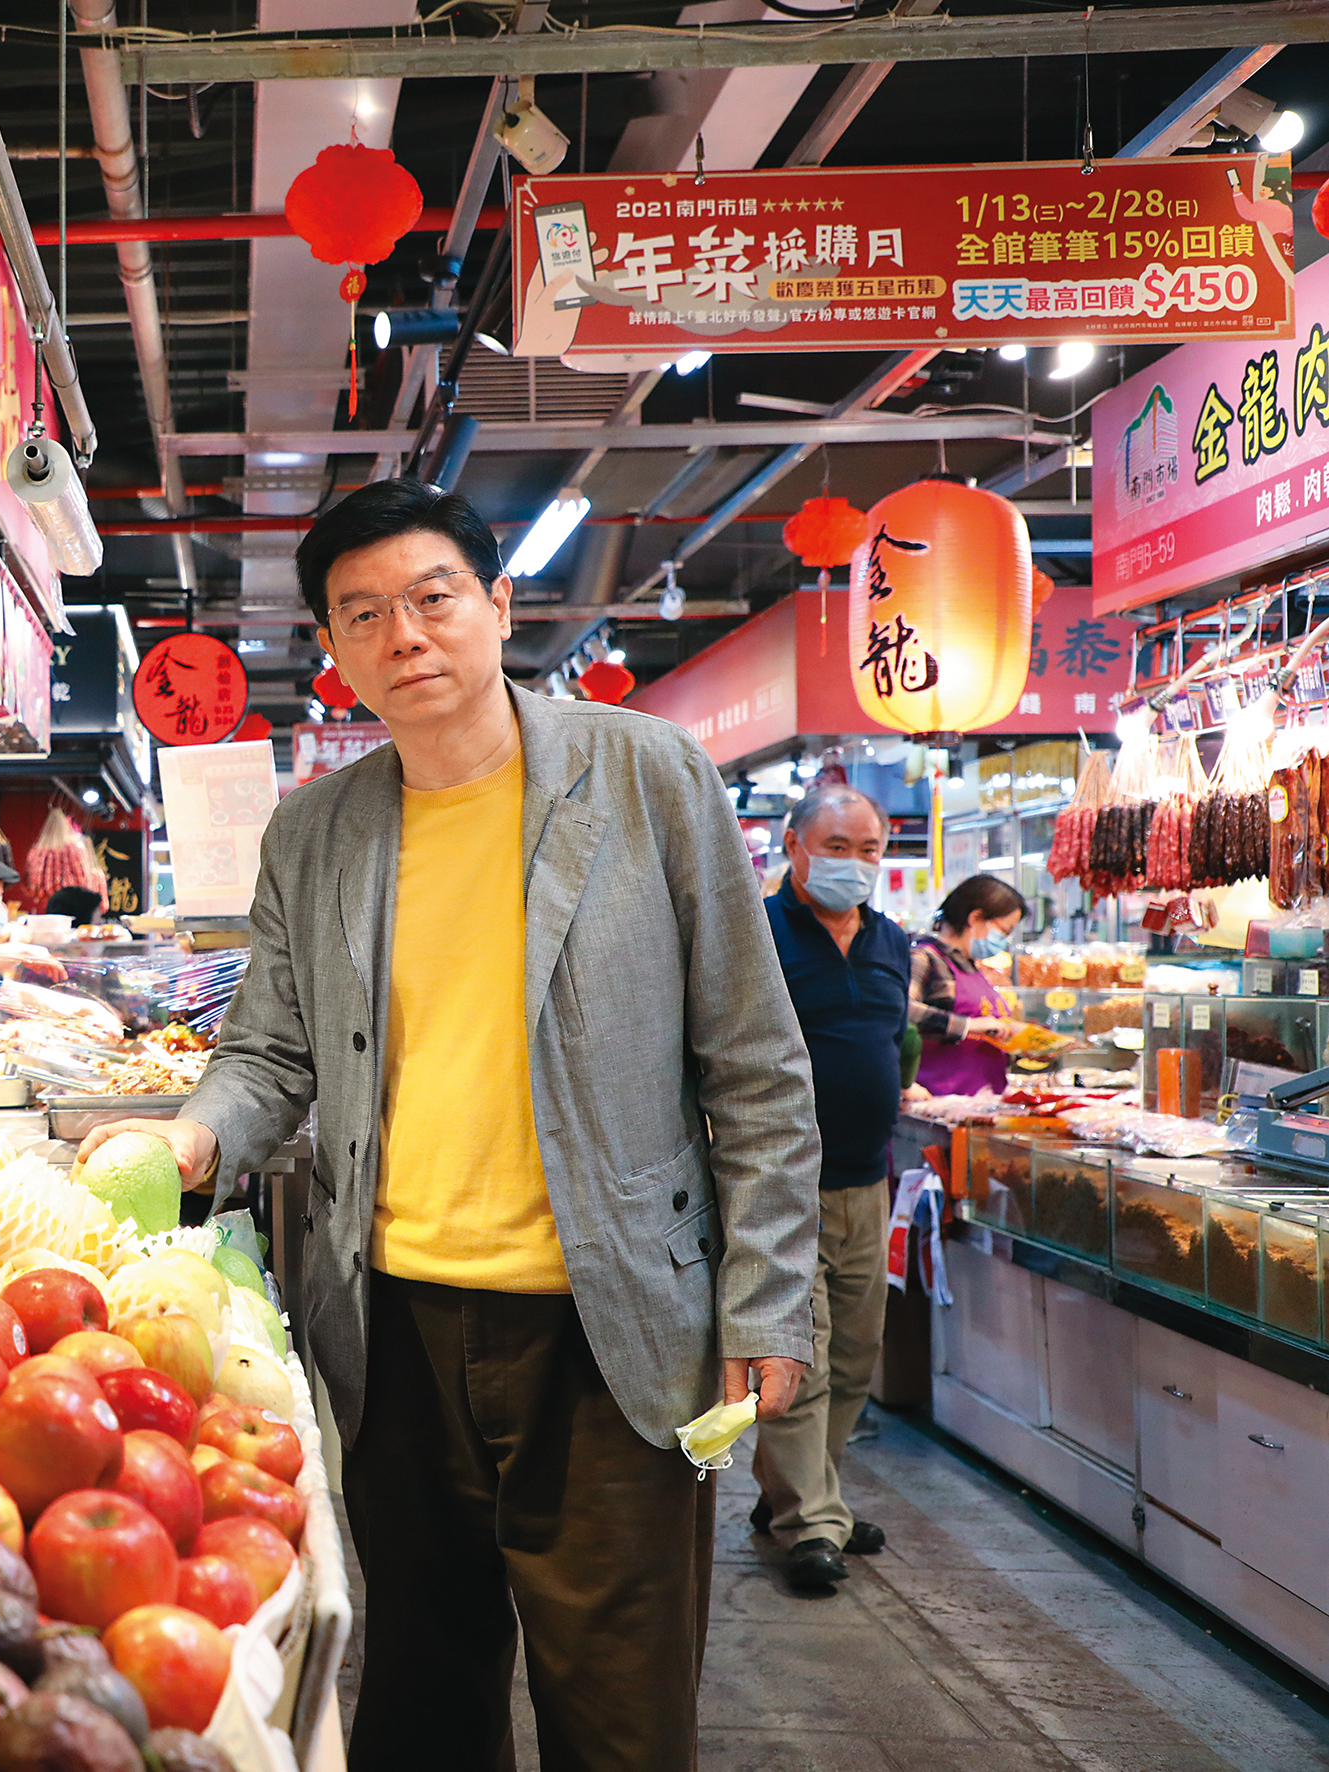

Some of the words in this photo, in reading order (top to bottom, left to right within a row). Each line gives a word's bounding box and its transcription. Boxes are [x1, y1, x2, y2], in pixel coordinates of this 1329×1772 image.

[615, 197, 758, 218] 2021南門市場
[612, 224, 905, 302] 年菜採購月
[956, 223, 1256, 267] 全館筆筆15%回饋
[775, 278, 937, 299] 歡慶榮獲五星市集
[1115, 531, 1176, 582] 南門B-59
[859, 523, 939, 698] 金龍
[146, 647, 209, 736] 金龍
